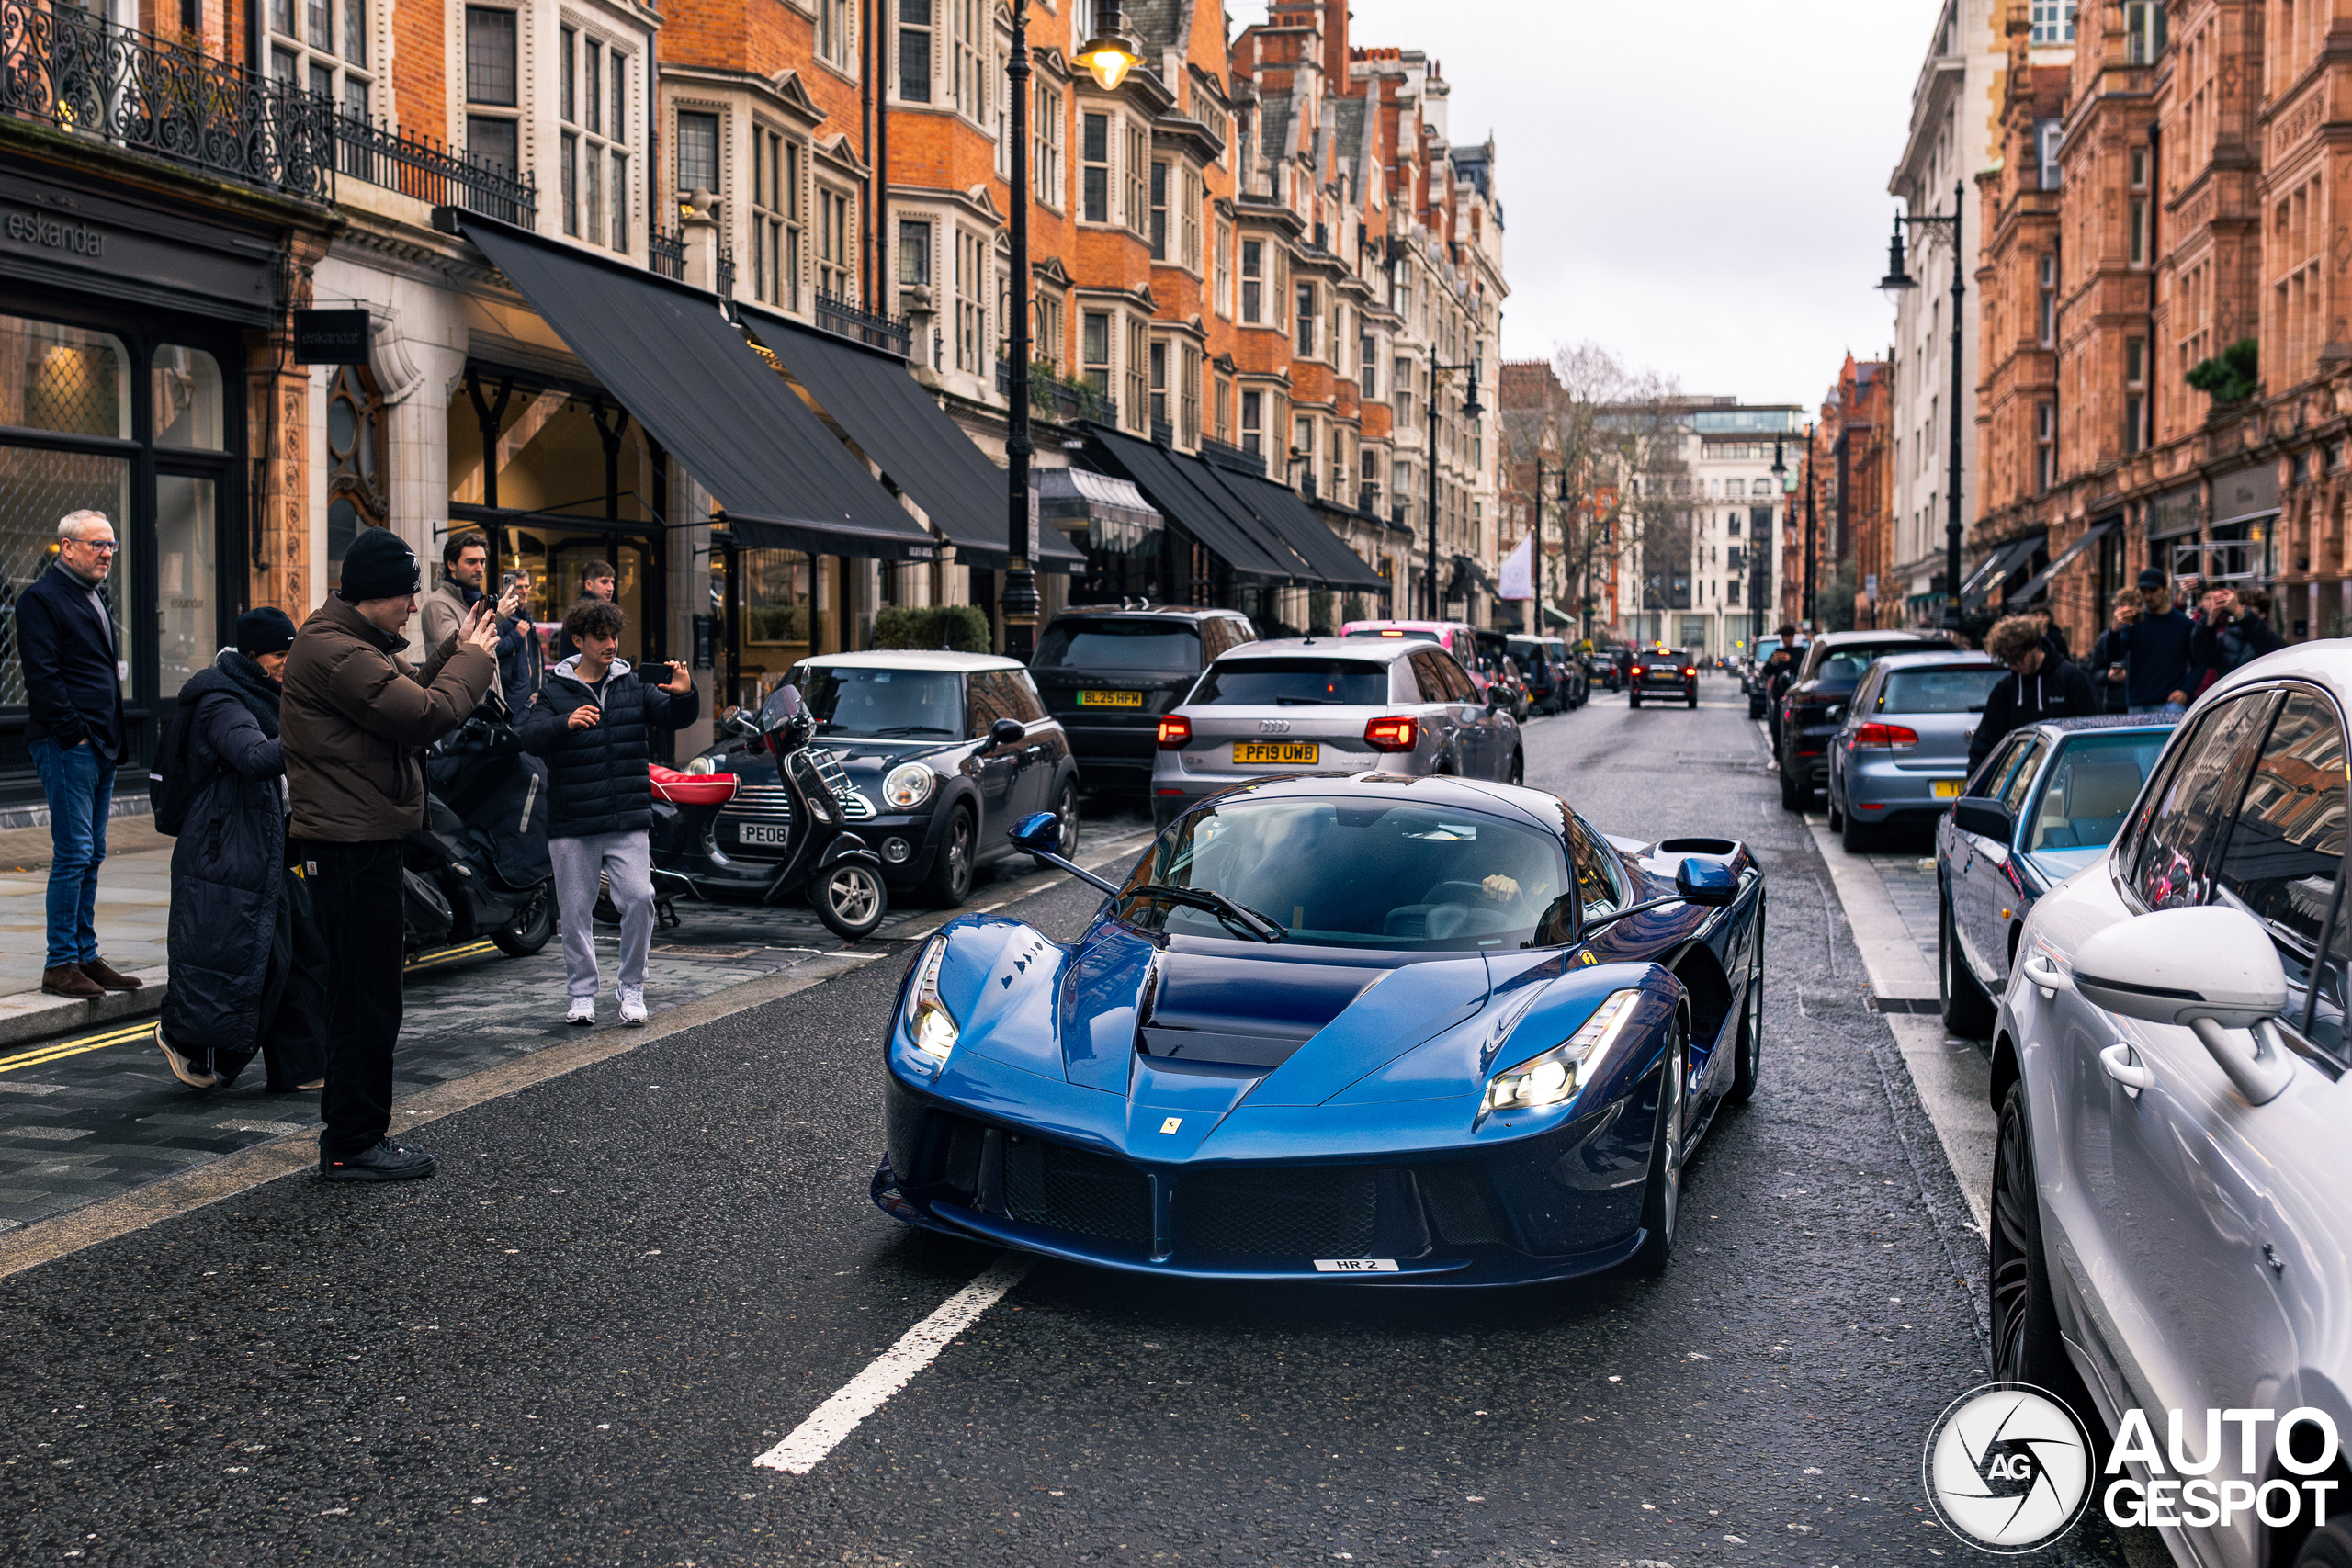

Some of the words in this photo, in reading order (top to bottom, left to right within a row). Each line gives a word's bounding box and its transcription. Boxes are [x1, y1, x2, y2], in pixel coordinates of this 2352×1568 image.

[9, 212, 107, 256] eskandar
[174, 382, 196, 411] 27
[1084, 692, 1114, 704] BL25
[1116, 693, 1140, 705] HFM
[1246, 746, 1280, 760] PF19
[1283, 747, 1314, 761] UWB
[746, 827, 786, 842] PE08
